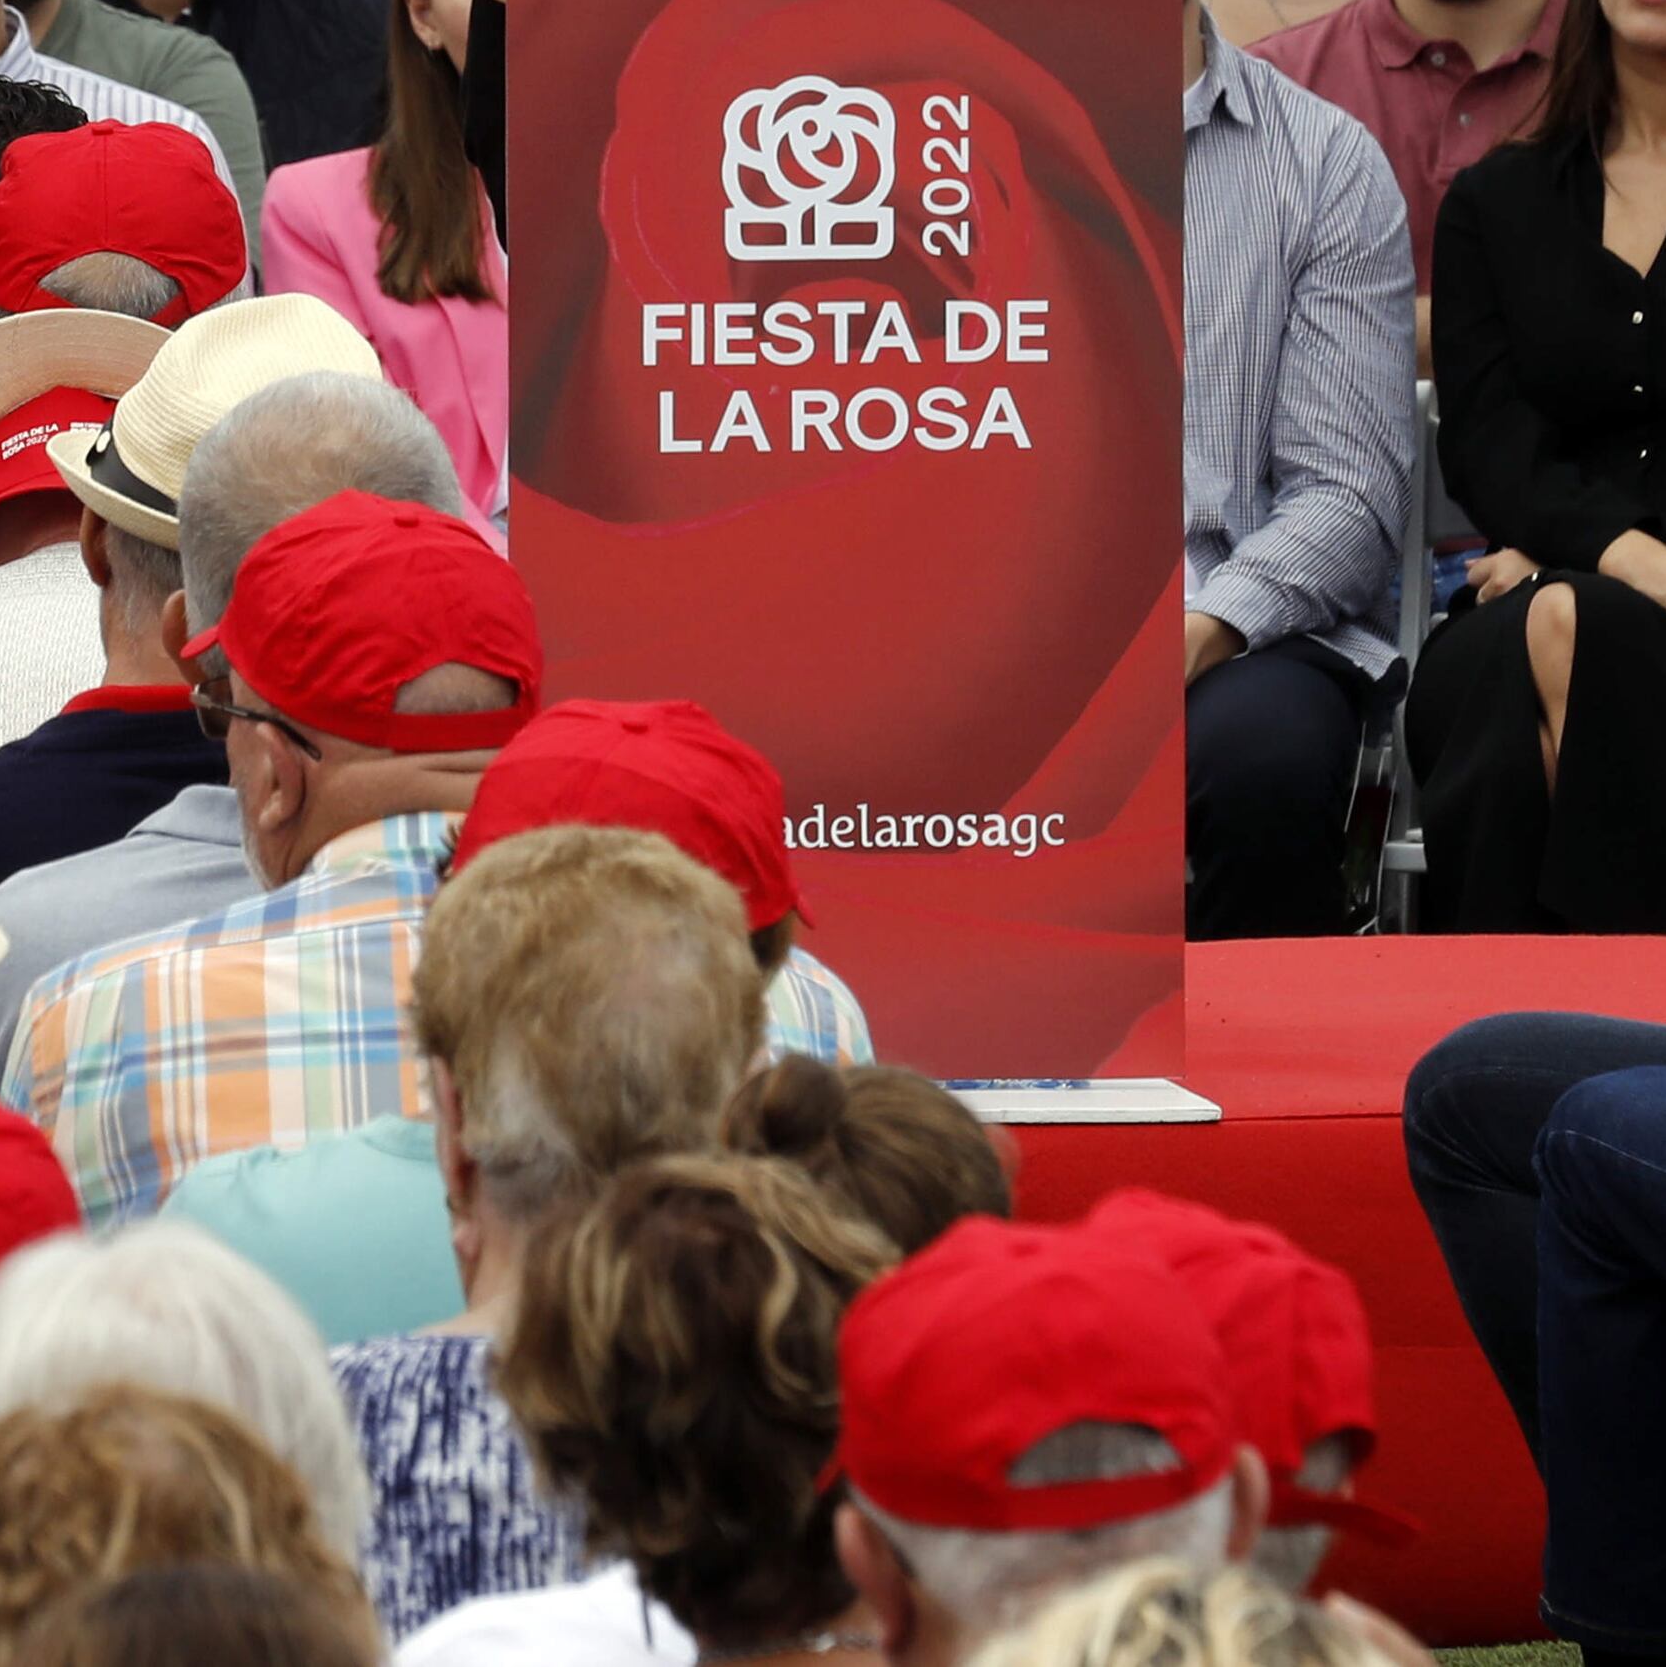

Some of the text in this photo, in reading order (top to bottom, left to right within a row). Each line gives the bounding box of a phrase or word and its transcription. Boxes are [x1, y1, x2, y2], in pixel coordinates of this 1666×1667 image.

[921, 94, 971, 257] 2022
[641, 299, 1050, 367] FIESTA DE
[0, 430, 29, 450] FIESTA
[30, 425, 44, 436] DE
[45, 423, 59, 433] LA
[1, 434, 49, 460] ROSA 2022
[658, 385, 1033, 454] LA ROSA
[782, 803, 1065, 858] adelarosagc
